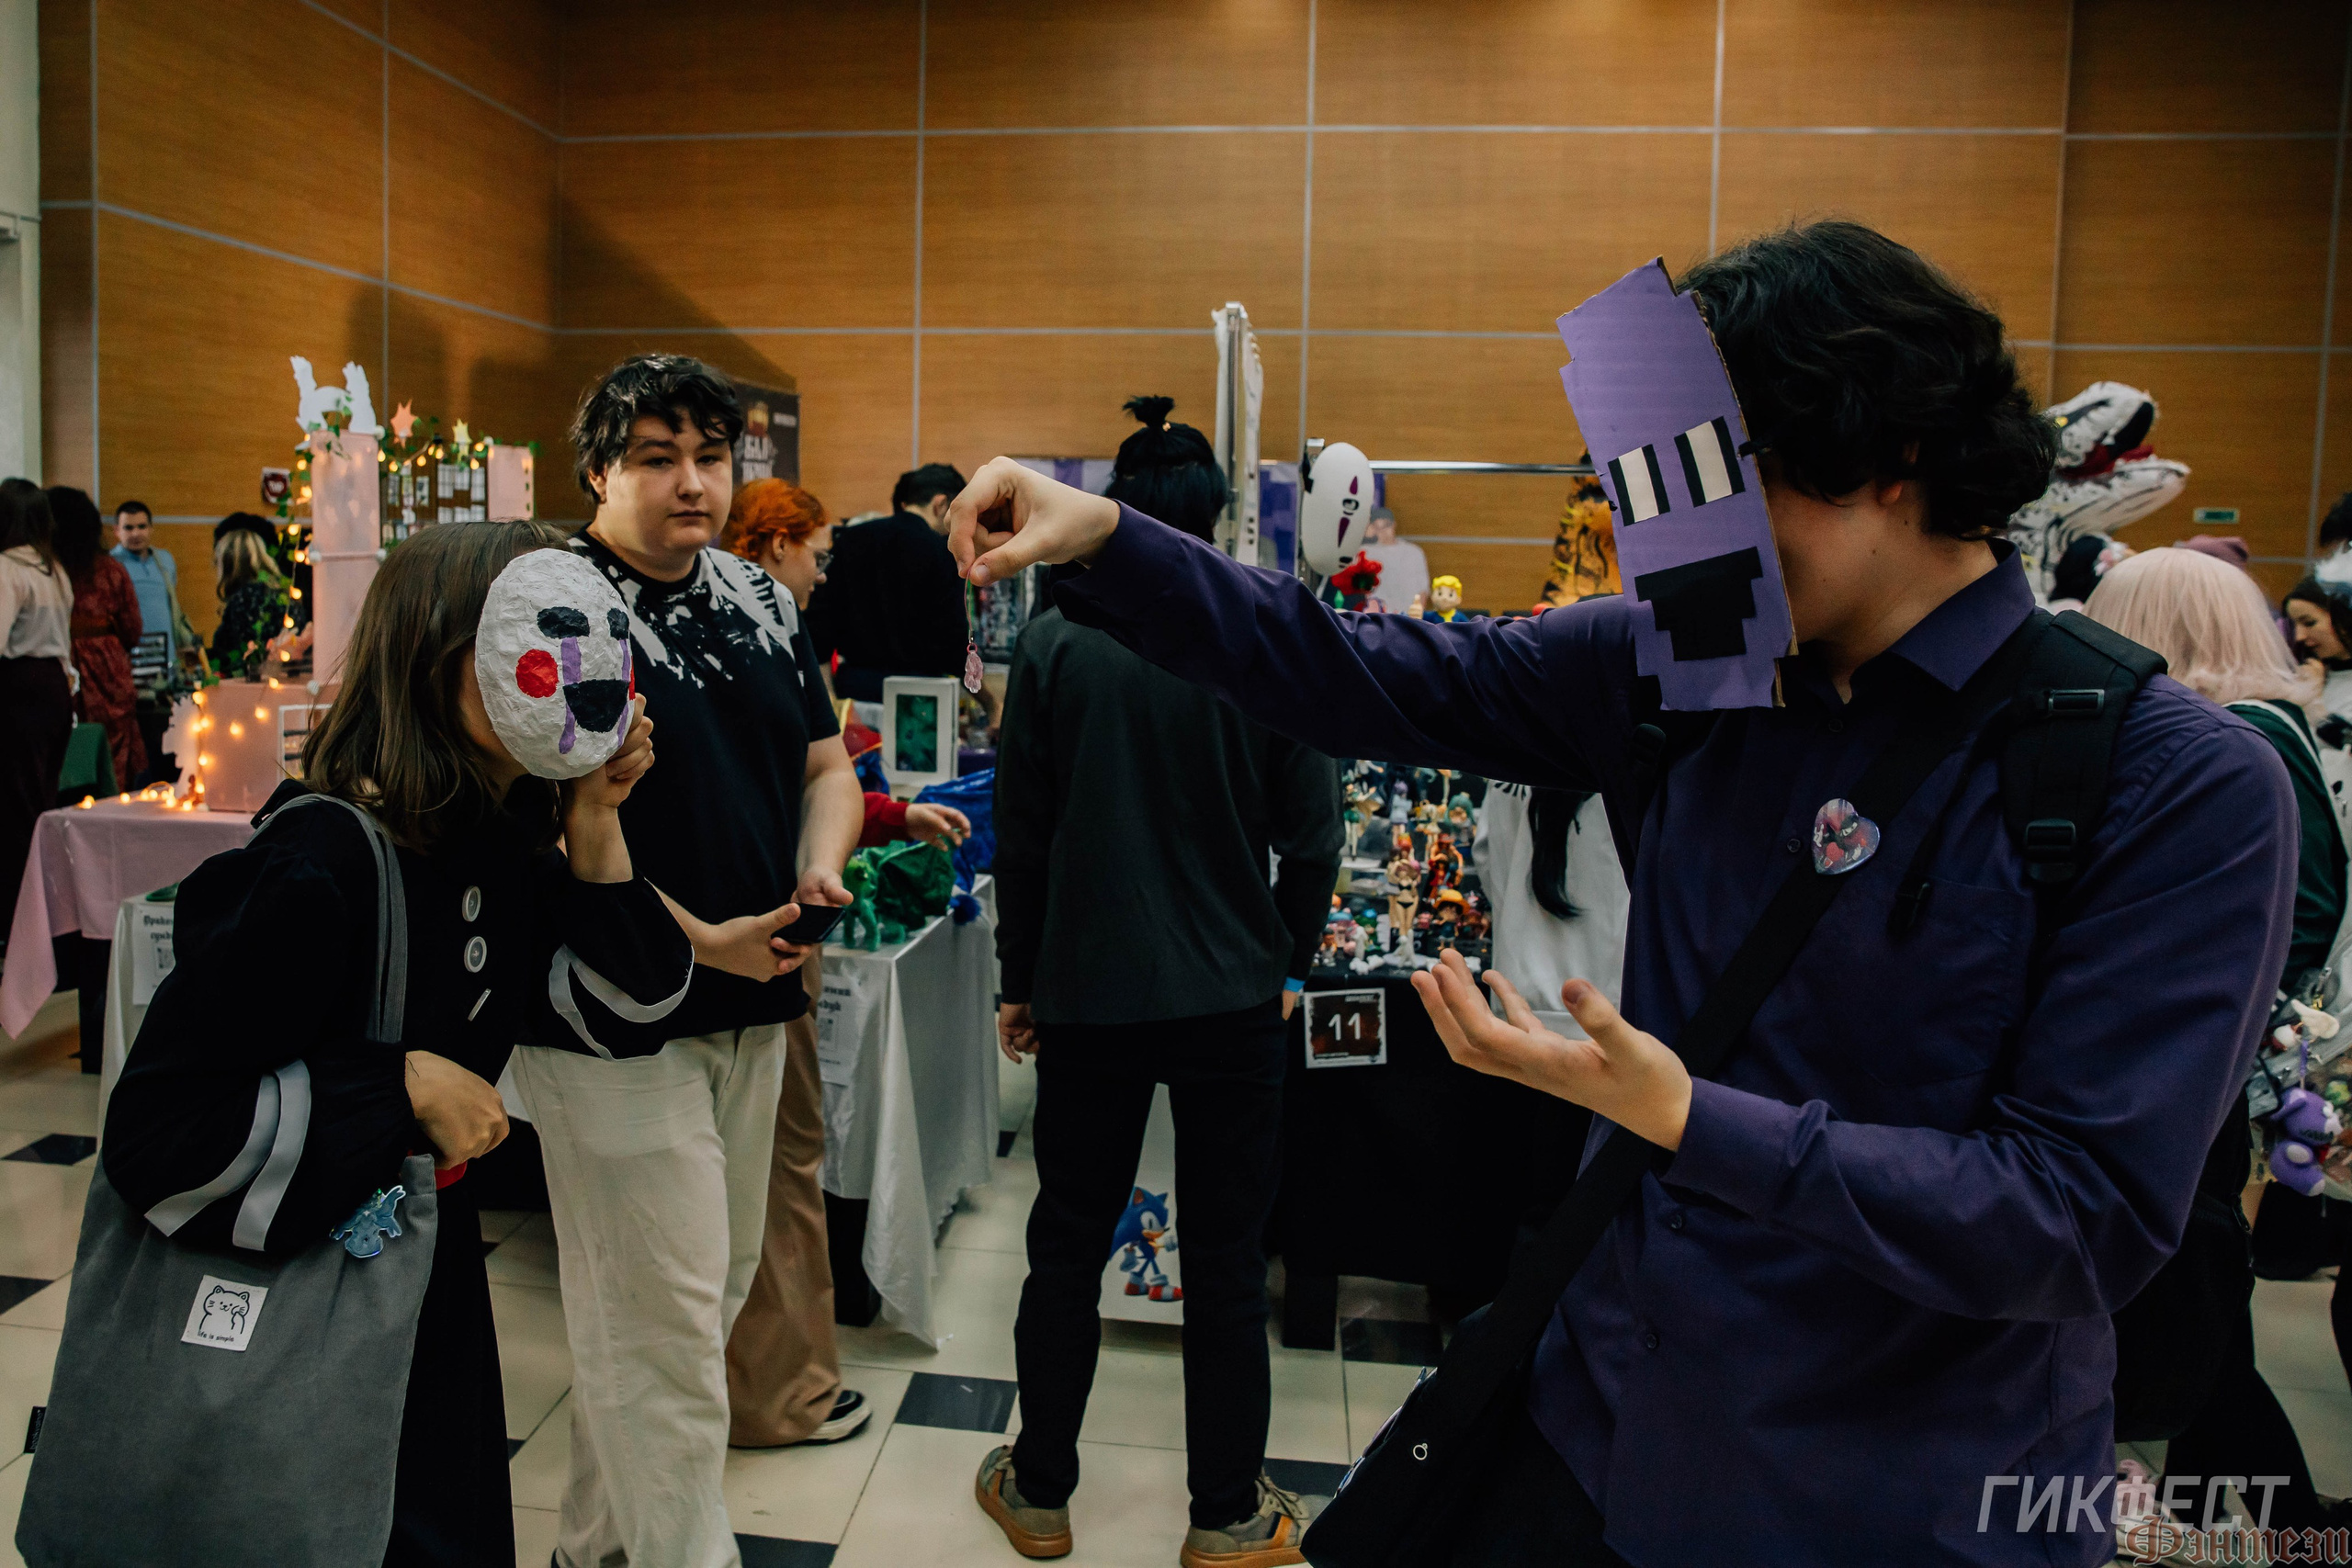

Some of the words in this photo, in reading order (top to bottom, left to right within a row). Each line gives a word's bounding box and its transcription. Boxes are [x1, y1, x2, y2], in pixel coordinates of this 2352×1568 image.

[1328, 1013, 1361, 1041] 11
[197, 1330, 208, 1338] life
[216, 1335, 235, 1343] simple
